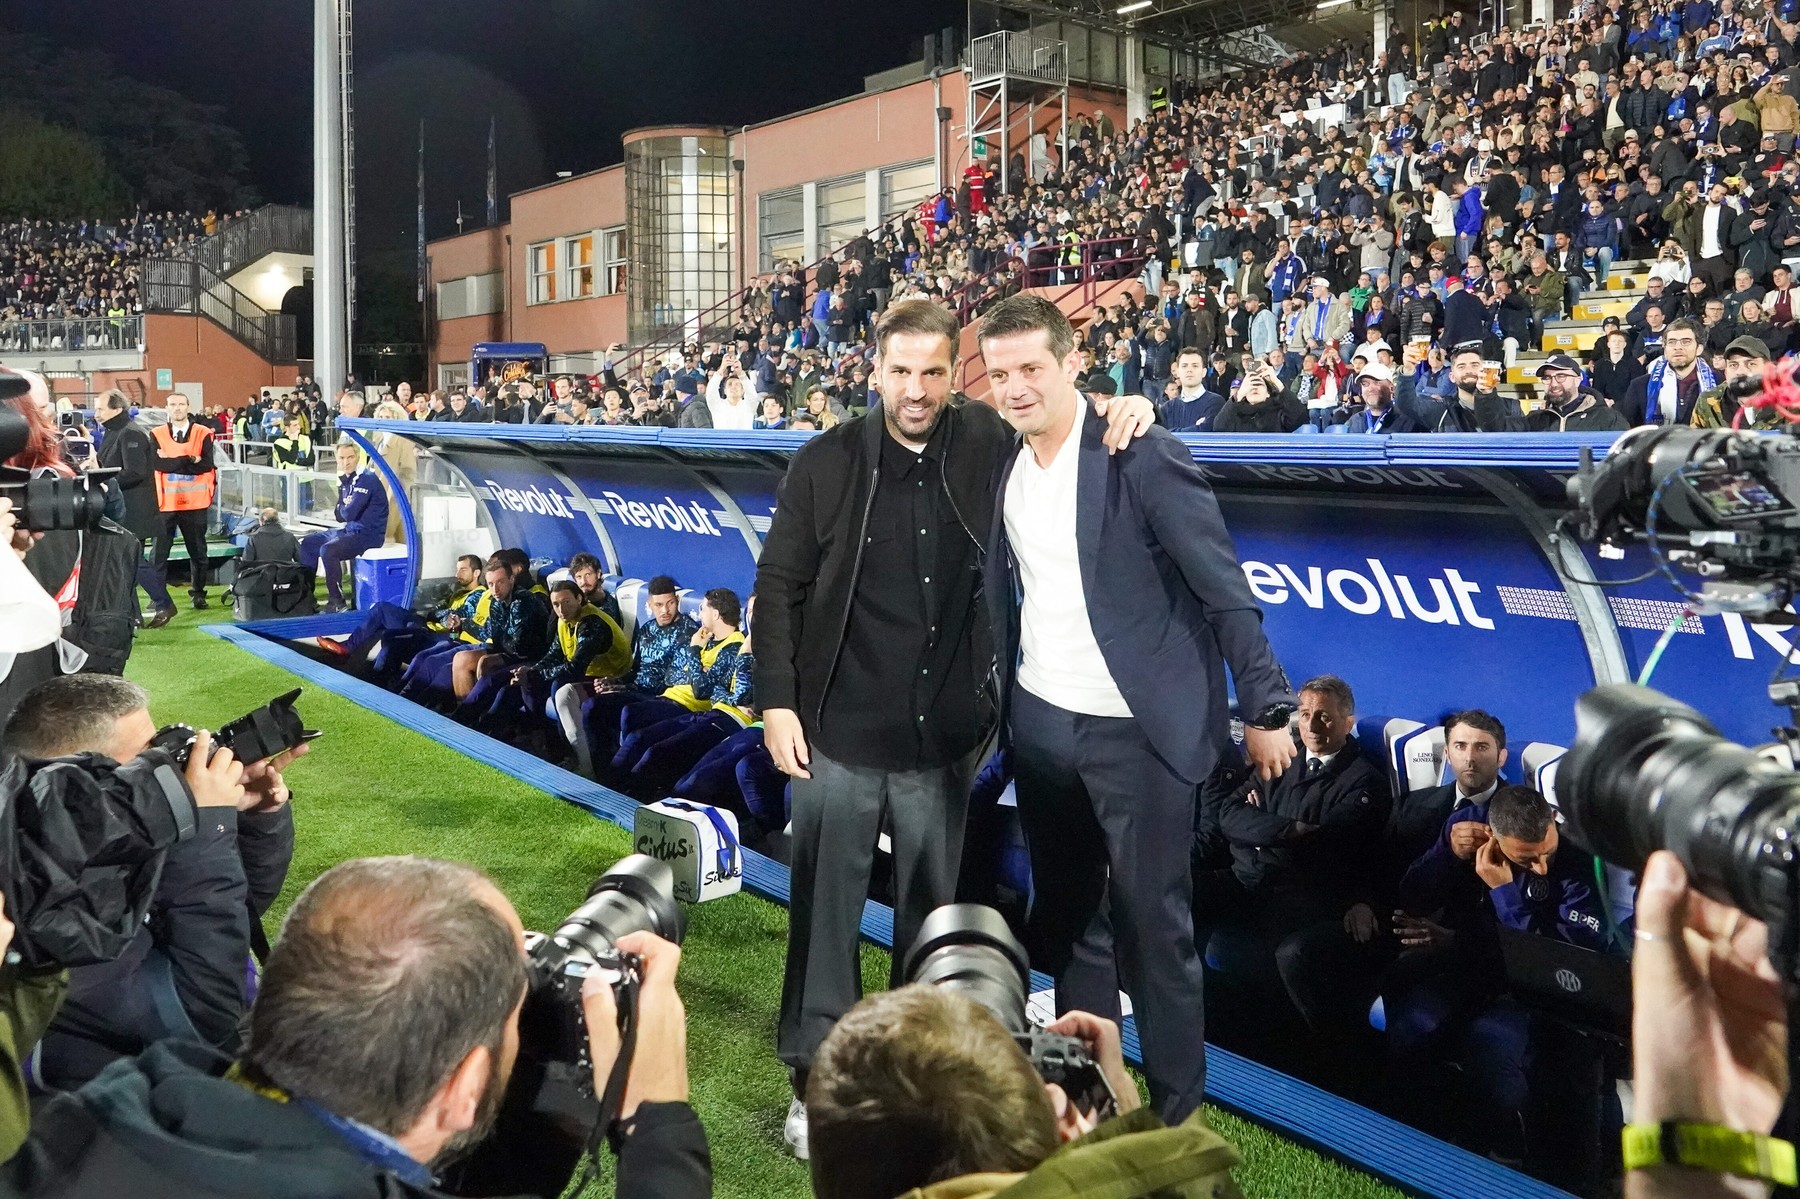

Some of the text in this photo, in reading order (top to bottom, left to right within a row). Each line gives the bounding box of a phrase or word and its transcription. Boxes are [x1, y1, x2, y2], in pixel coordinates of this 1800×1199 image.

[1241, 463, 1463, 488] Revolut
[485, 480, 574, 519] Revolut
[603, 491, 721, 536] Revolut
[1240, 558, 1496, 630] evolut
